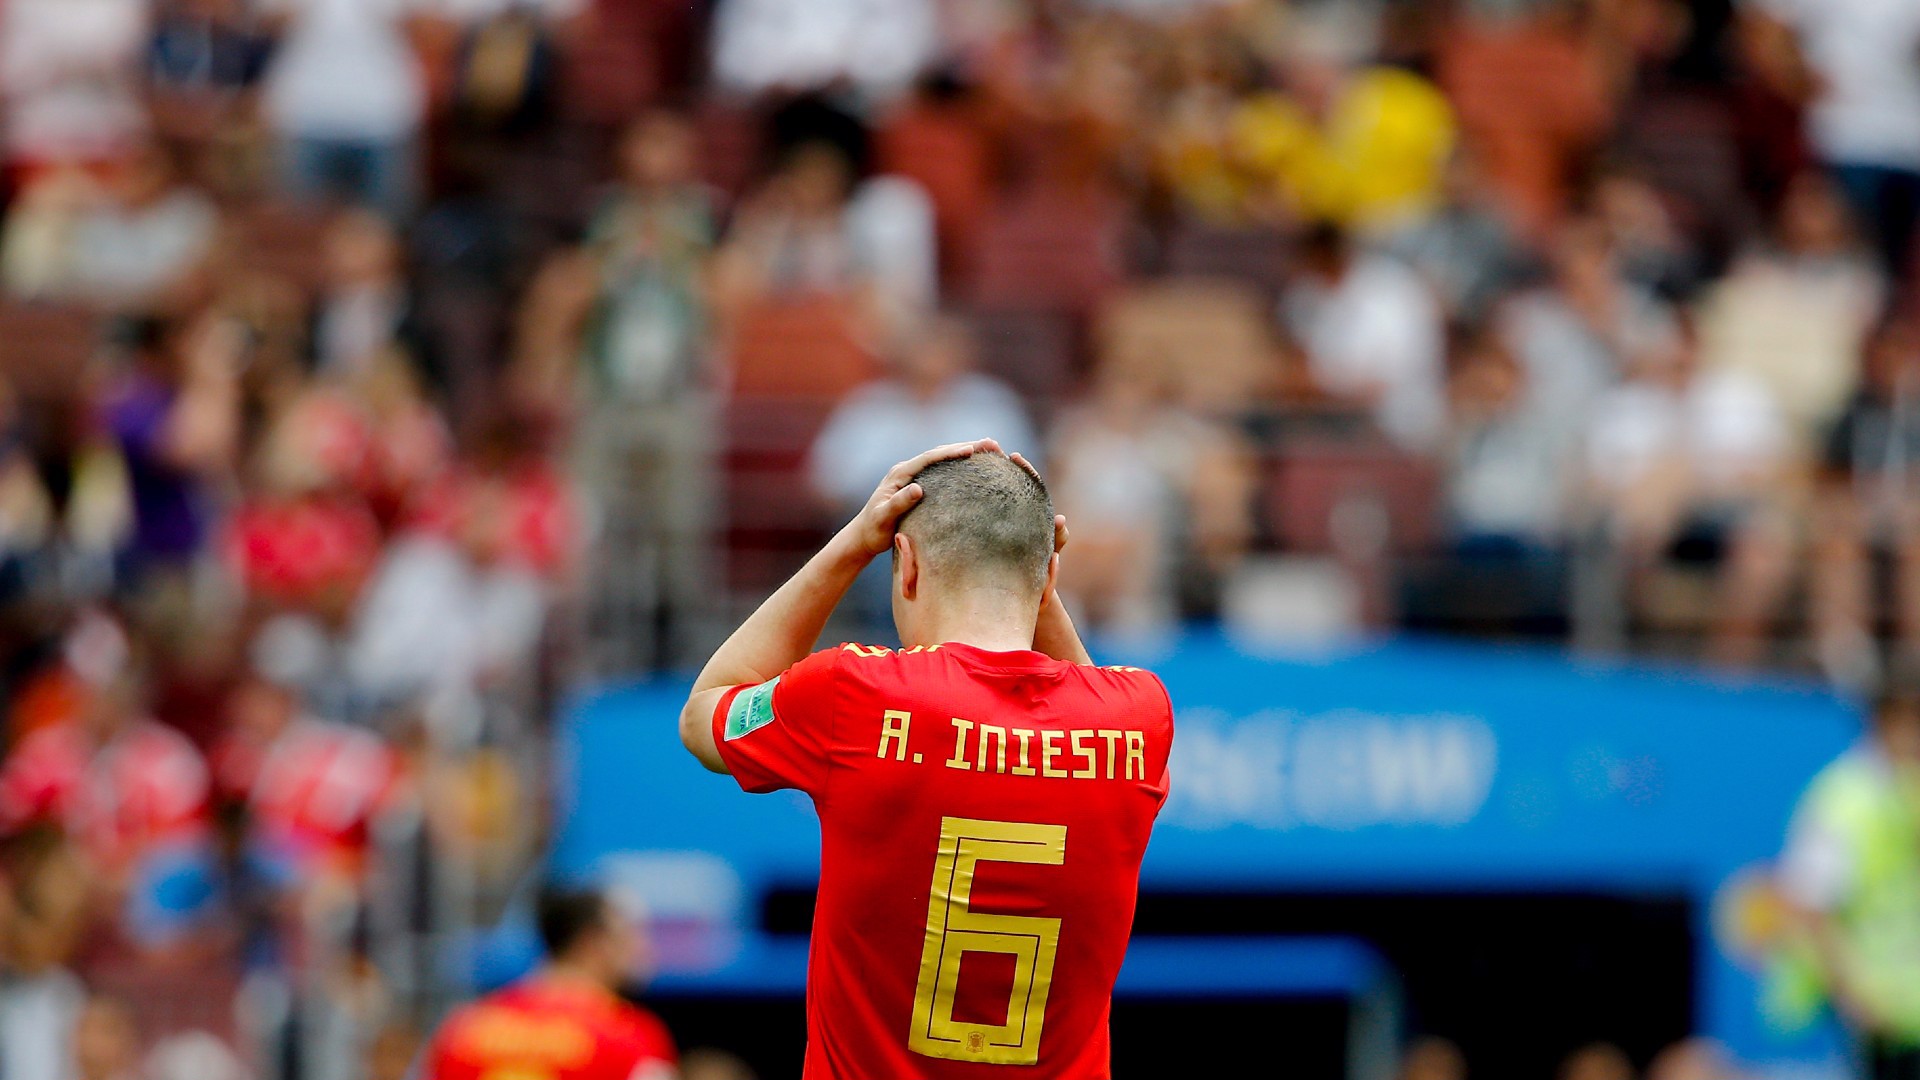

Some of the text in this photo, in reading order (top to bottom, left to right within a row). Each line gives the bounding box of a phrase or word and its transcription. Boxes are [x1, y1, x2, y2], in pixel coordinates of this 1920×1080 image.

[877, 709, 1146, 781] A. INIESTA
[908, 816, 1068, 1066] 6
